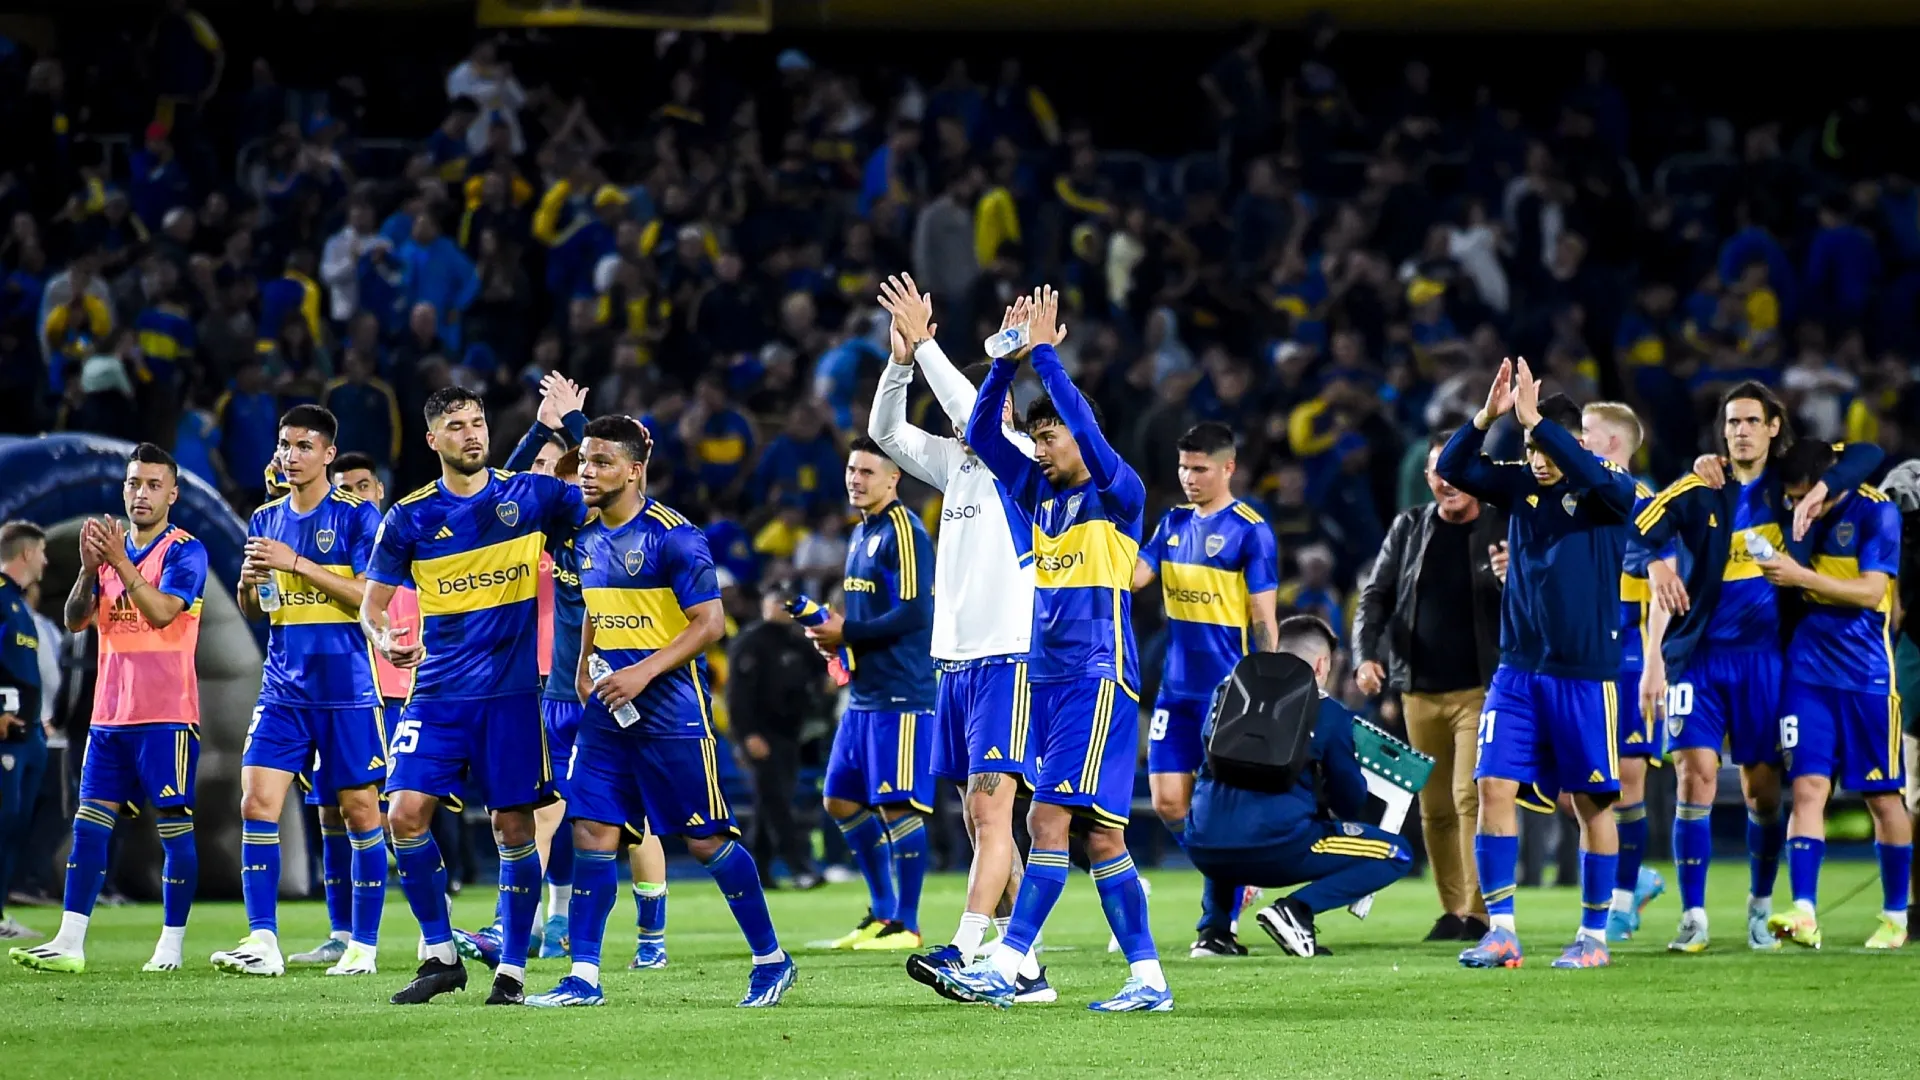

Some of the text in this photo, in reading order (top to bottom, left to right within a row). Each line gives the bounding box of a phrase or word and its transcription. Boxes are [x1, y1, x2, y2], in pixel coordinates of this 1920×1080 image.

[1035, 551, 1084, 571] tsson
[437, 563, 530, 595] betsson
[590, 611, 654, 629] etsson
[1668, 682, 1694, 717] 10
[388, 720, 423, 757] 25
